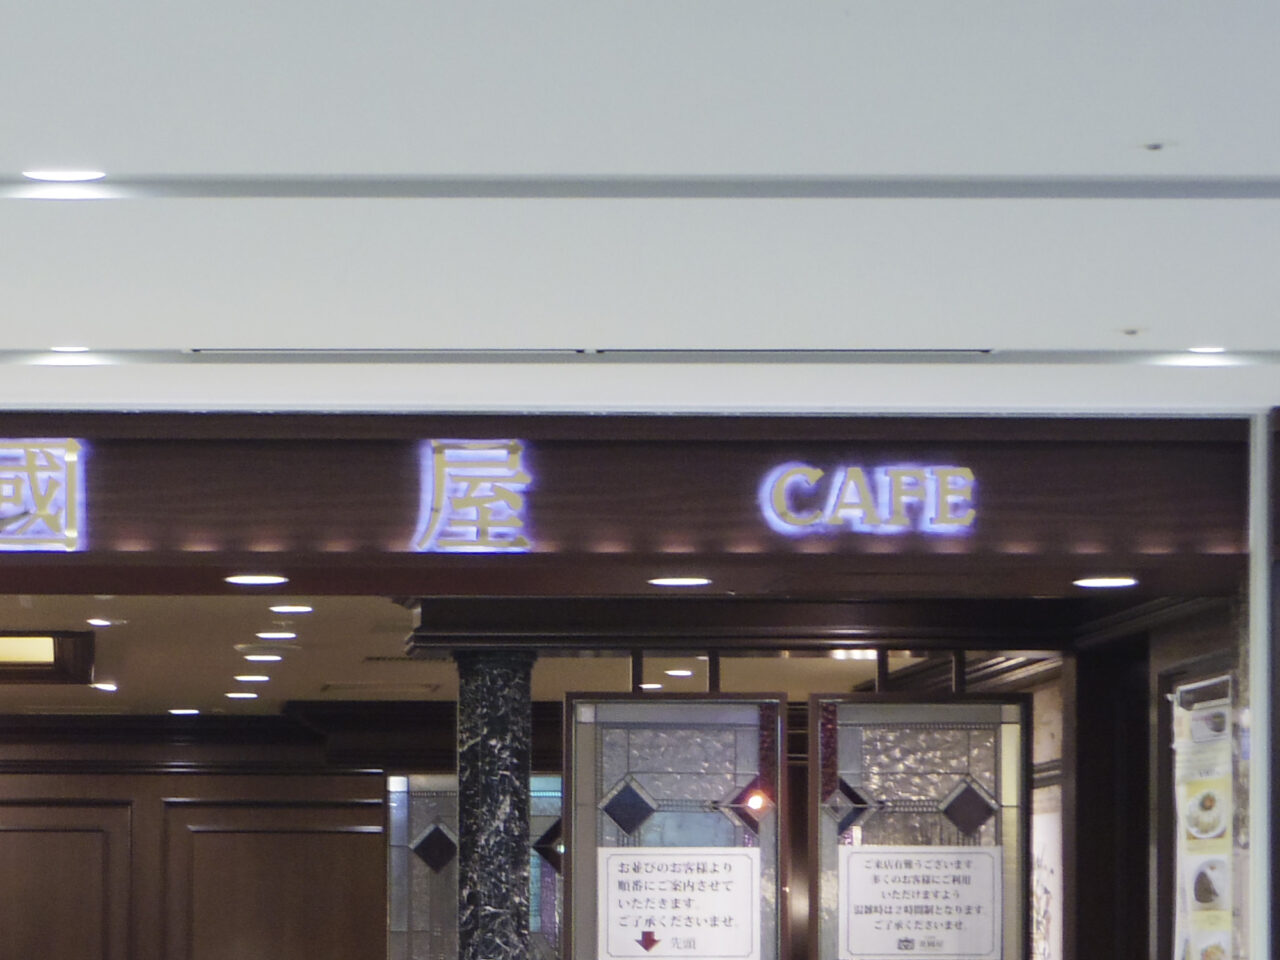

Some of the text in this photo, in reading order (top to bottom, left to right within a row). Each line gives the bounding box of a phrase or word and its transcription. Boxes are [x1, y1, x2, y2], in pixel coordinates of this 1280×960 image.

[767, 463, 977, 528] CAFE
[618, 861, 733, 874] お並びのお客様より
[618, 880, 734, 892] 順番にご案内させて
